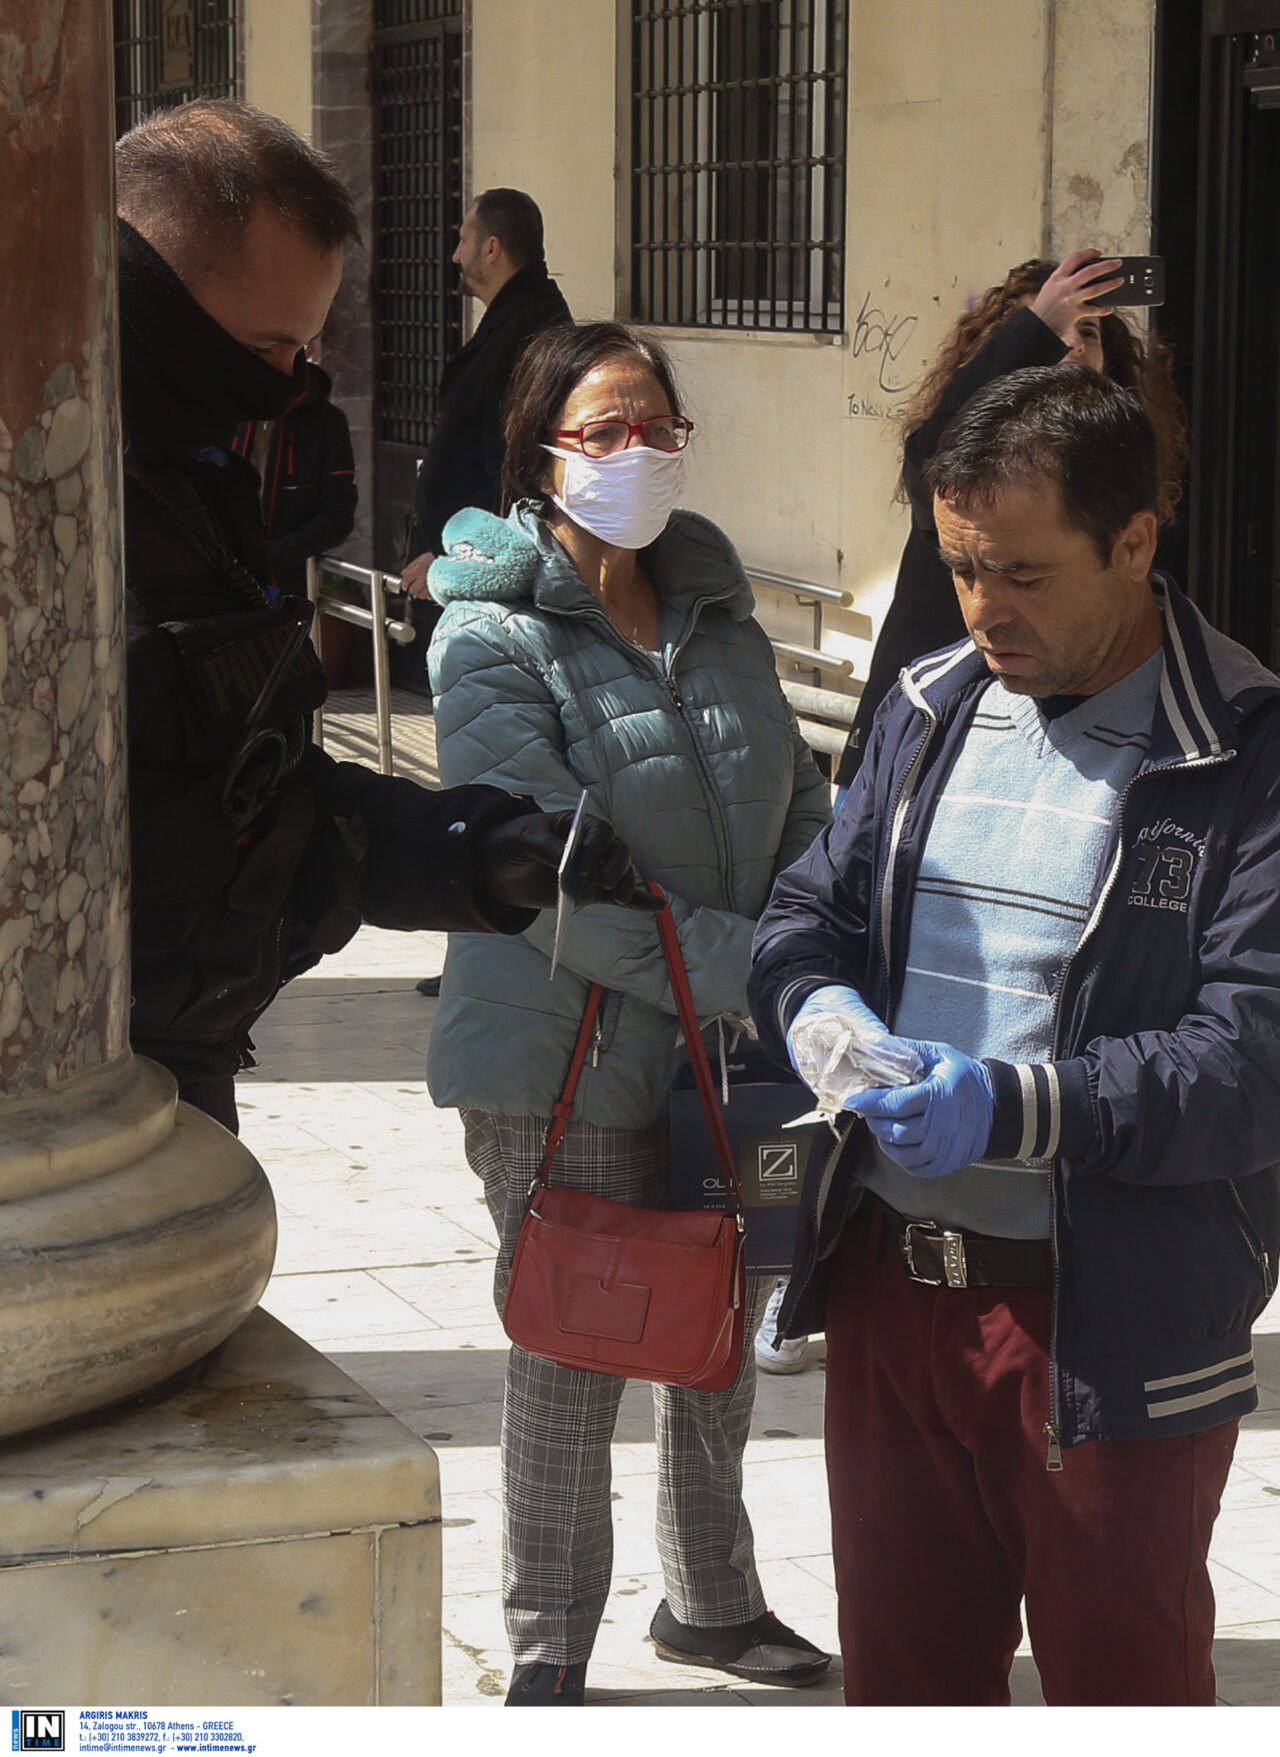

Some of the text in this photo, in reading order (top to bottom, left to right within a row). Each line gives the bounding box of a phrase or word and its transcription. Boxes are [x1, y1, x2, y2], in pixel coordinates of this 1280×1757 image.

[1131, 846, 1194, 900] 13
[1127, 895, 1189, 913] COLLEGE
[762, 1148, 793, 1177] Z
